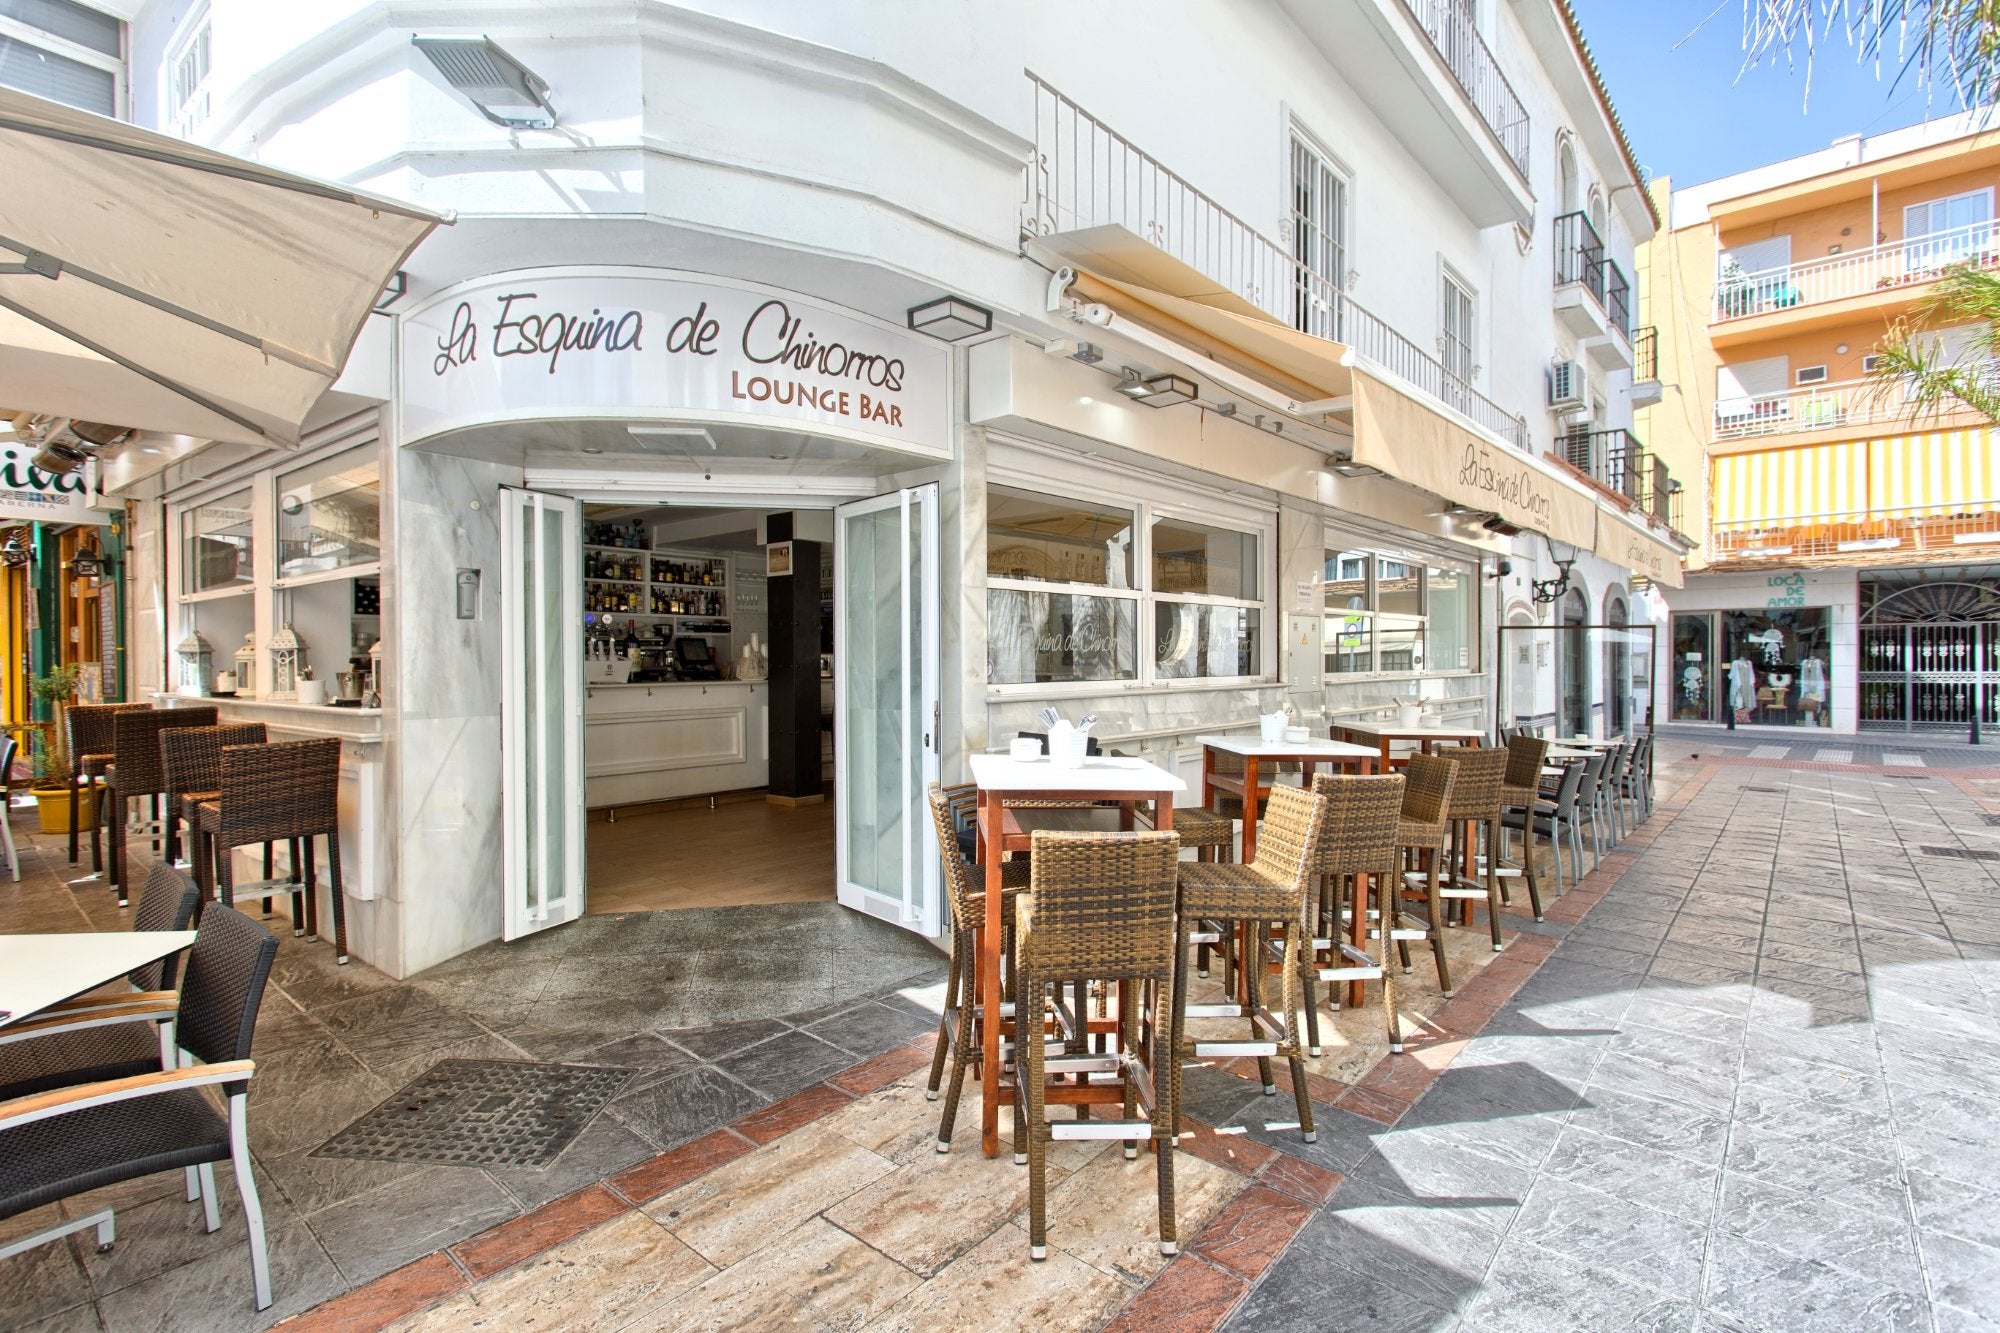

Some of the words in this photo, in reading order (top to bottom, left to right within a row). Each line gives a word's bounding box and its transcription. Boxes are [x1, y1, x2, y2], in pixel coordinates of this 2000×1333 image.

[433, 301, 477, 376] La
[493, 293, 643, 374] Esquina
[666, 302, 720, 355] de
[742, 300, 905, 392] Chinorros
[731, 370, 850, 416] LOUNGE
[860, 393, 903, 428] BAR
[0, 450, 88, 495] iva
[1767, 575, 1806, 587] LOCA
[1786, 586, 1805, 596] DE
[1767, 597, 1805, 607] AMOR
